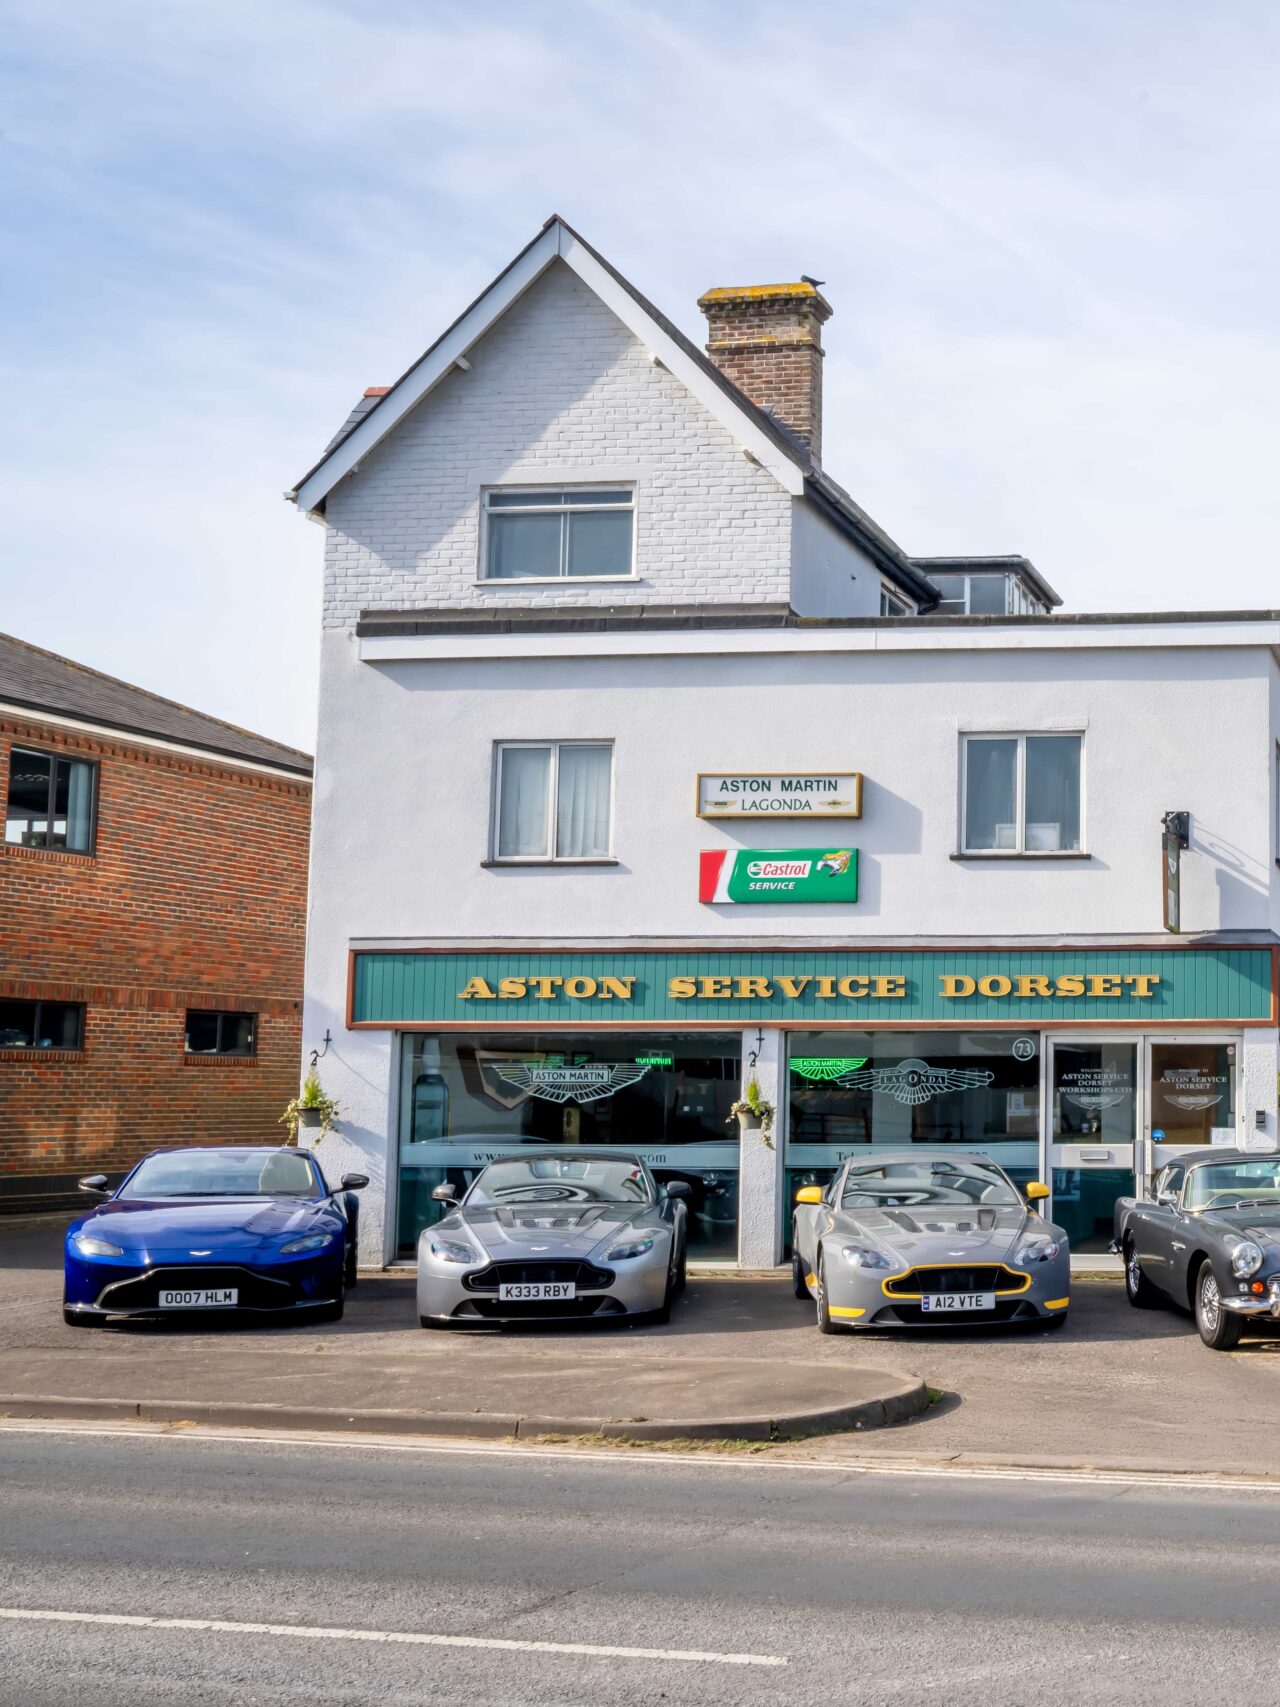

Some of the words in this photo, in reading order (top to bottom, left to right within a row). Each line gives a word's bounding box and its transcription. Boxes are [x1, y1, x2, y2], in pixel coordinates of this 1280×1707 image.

[719, 780, 772, 793] ASTON
[780, 779, 838, 792] MARTIN
[741, 799, 813, 811] LAGONDA
[762, 863, 807, 876] Castrol
[749, 881, 796, 890] SERVICE
[456, 976, 638, 999] ASTON
[667, 976, 907, 999] SERVICE
[938, 975, 1160, 998] DORSET
[1017, 1043, 1032, 1056] 73
[535, 1071, 566, 1081] ASTON
[569, 1071, 605, 1081] MARTIN
[883, 1073, 943, 1084] LAGONDA
[205, 1291, 232, 1303] HLM
[505, 1286, 540, 1298] K333
[543, 1285, 569, 1297] RBY
[935, 1296, 955, 1308] A12
[959, 1295, 983, 1307] VTE
